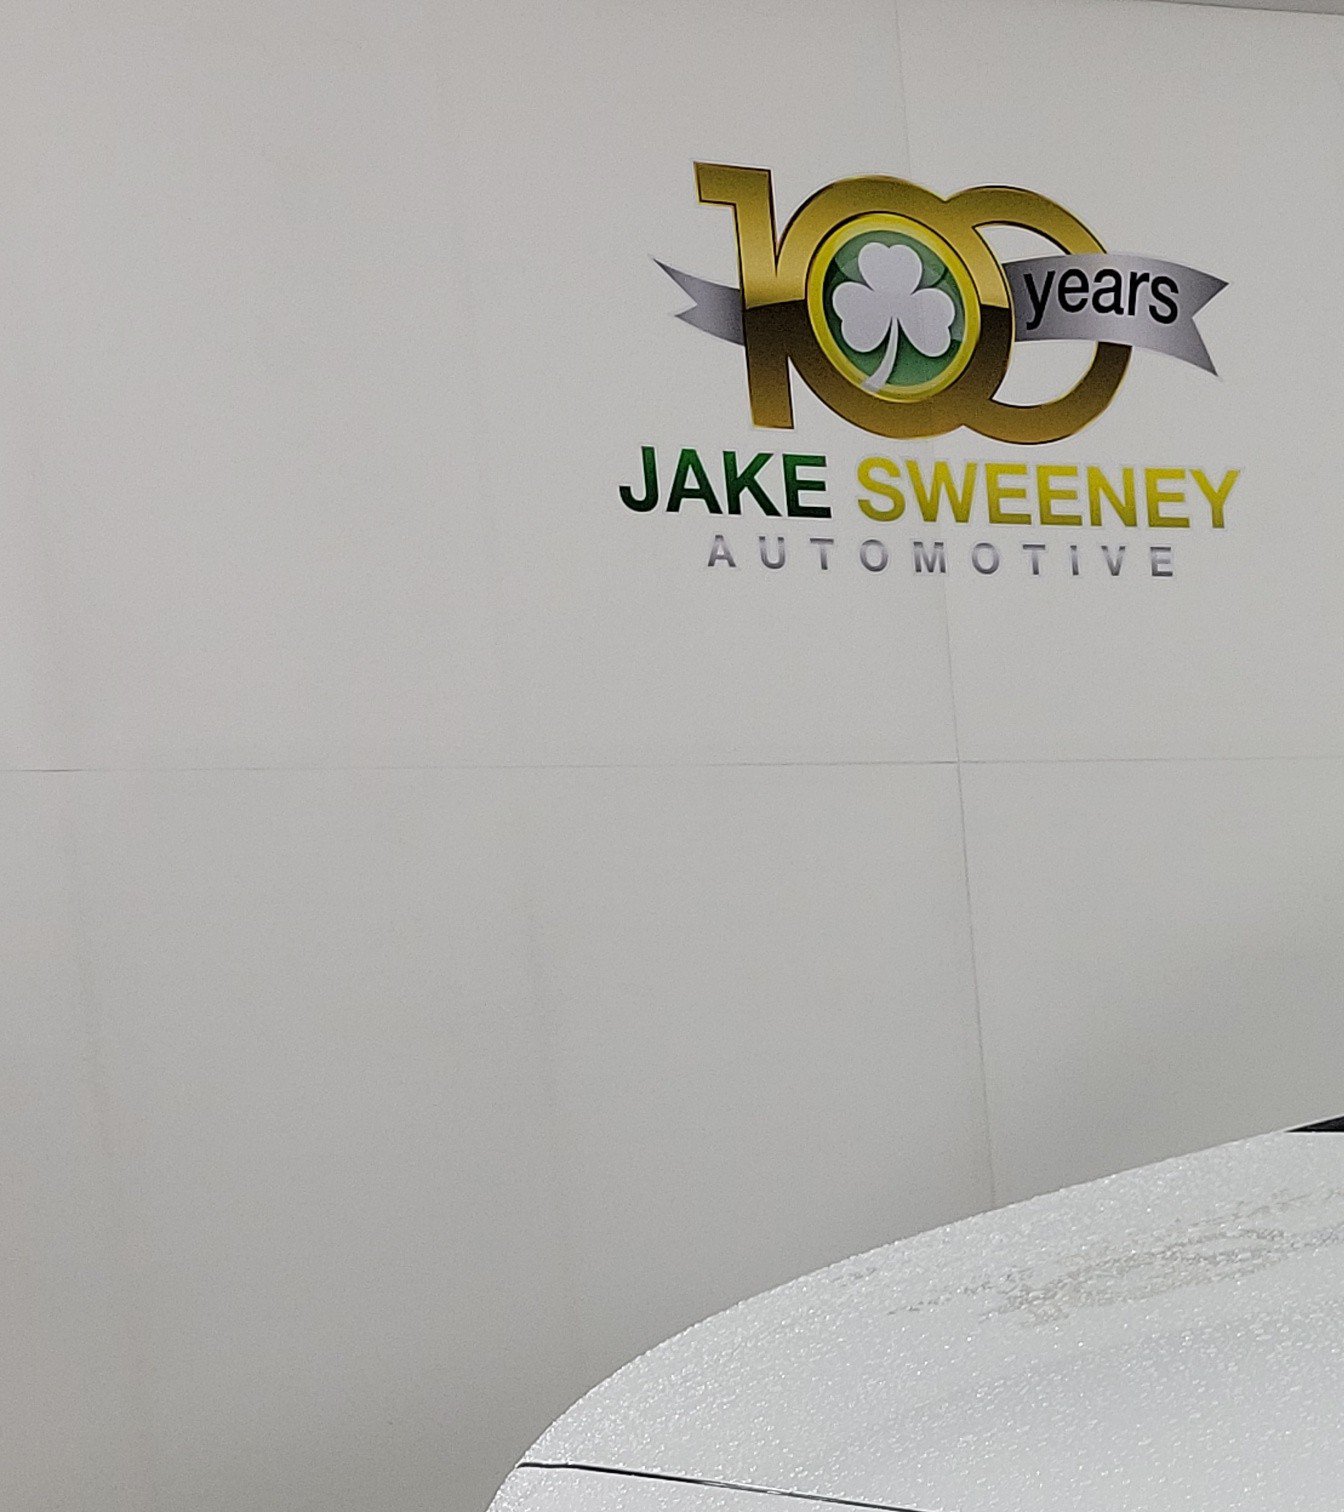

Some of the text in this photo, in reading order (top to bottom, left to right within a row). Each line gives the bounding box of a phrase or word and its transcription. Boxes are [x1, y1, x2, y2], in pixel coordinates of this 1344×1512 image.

[693, 160, 1180, 445] 100 years
[619, 445, 1241, 530] JAKE SWEENEY
[706, 534, 1175, 578] AUTOMOTIVE
